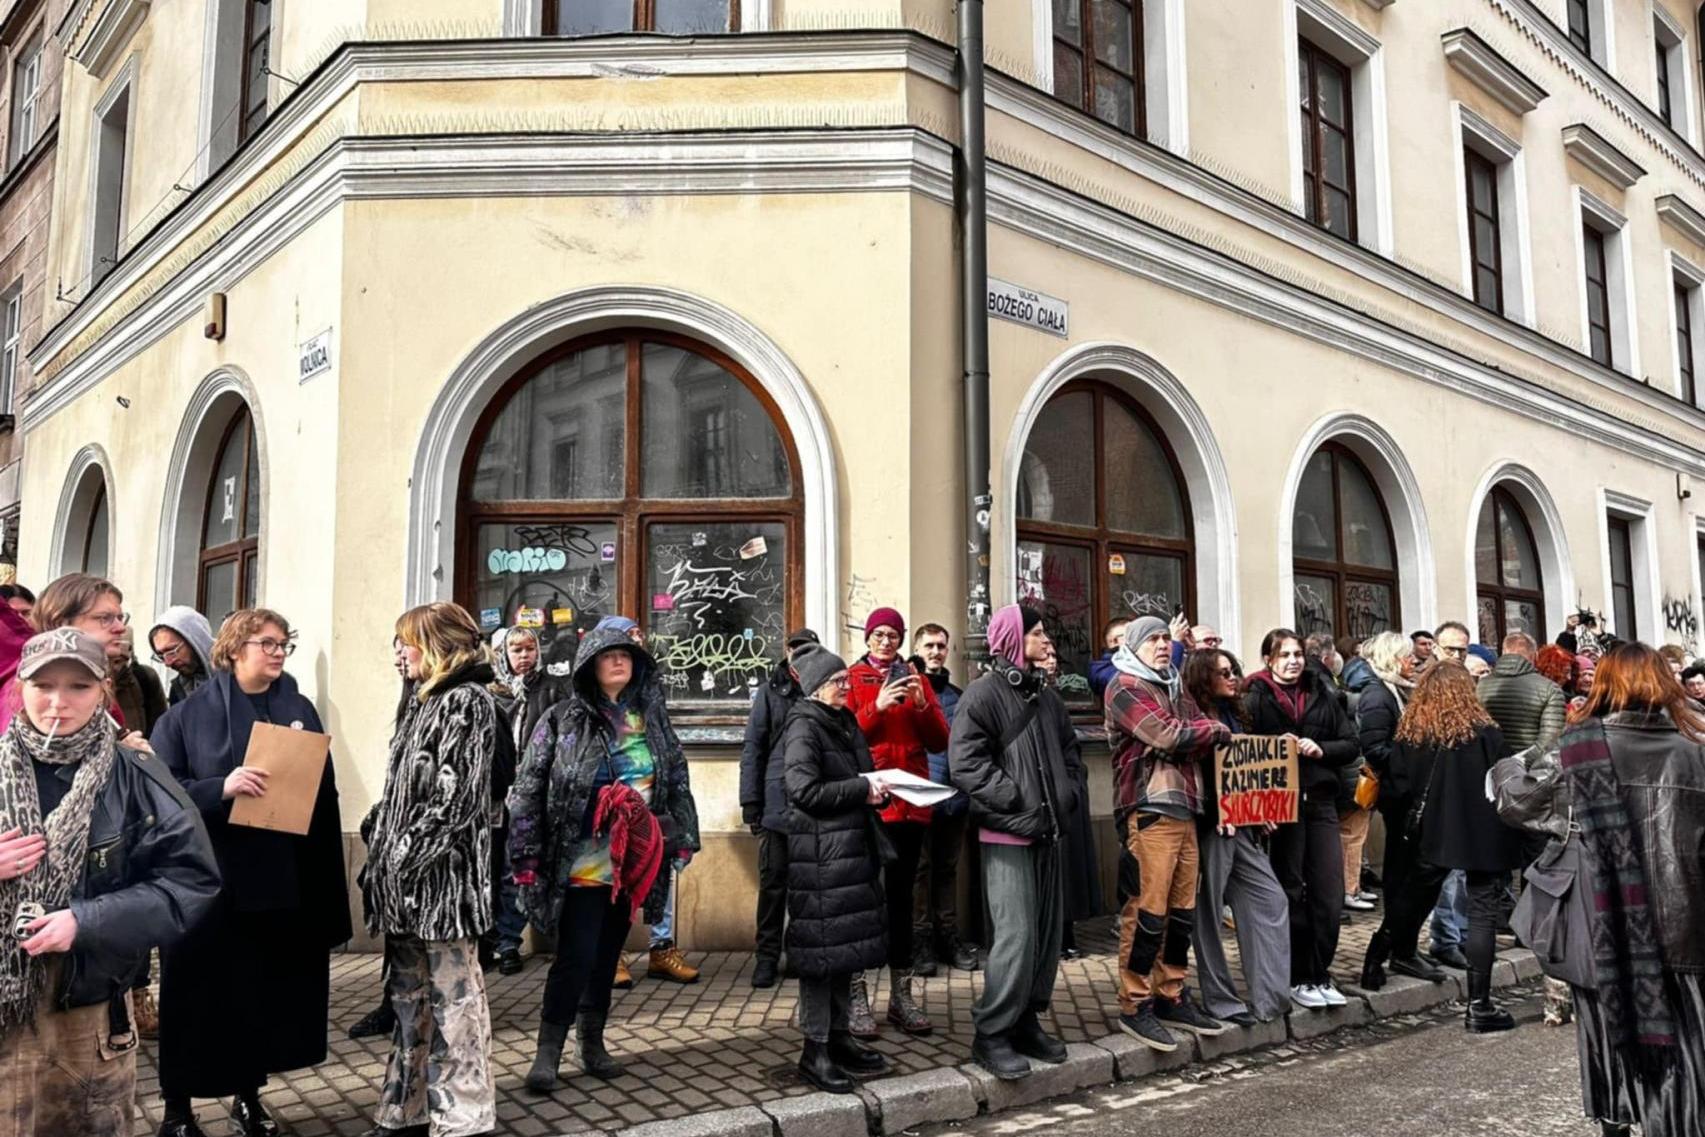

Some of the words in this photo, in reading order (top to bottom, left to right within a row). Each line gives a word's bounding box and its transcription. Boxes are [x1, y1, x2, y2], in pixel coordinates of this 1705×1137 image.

[1018, 289, 1040, 303] ULICA
[988, 292, 1033, 321] BOŻEGO
[1037, 307, 1065, 333] CIAŁA
